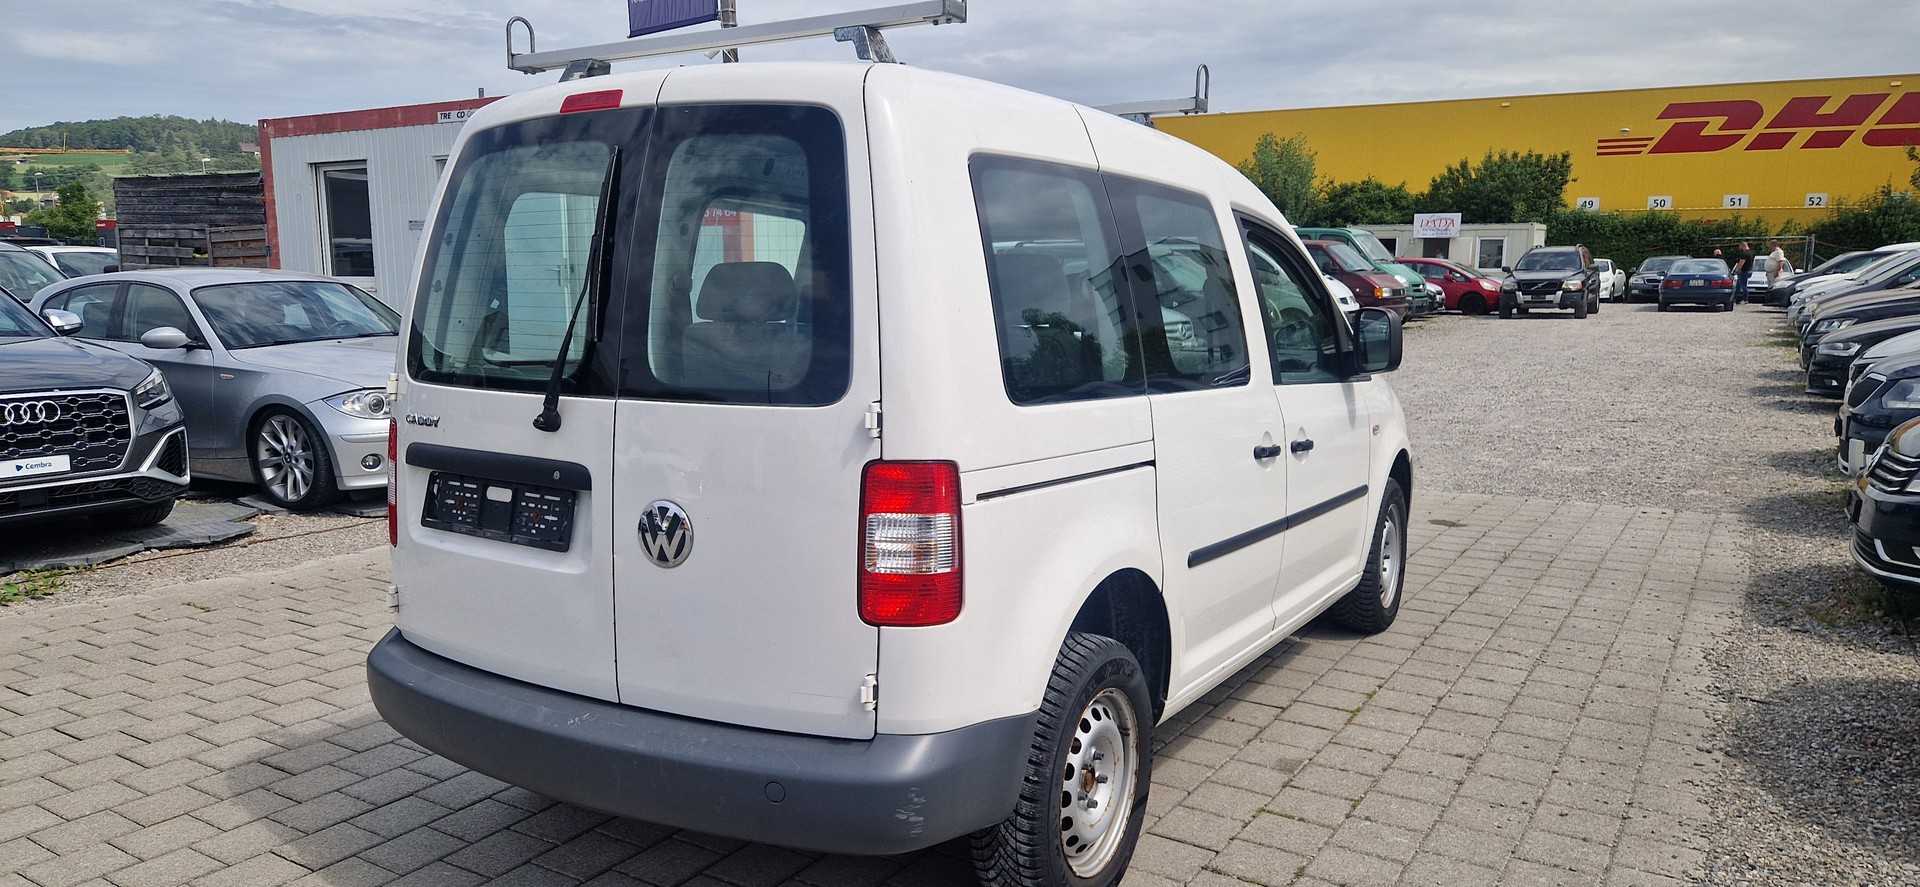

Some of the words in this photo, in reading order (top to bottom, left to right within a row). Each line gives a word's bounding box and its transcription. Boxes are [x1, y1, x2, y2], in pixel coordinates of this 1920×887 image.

[1581, 200, 1594, 208] 49
[1653, 199, 1666, 208] 50
[1729, 197, 1742, 206] 51
[1808, 196, 1822, 206] 52
[1420, 218, 1455, 228] DADA
[405, 413, 441, 428] CADDY
[25, 461, 53, 470] Cembra
